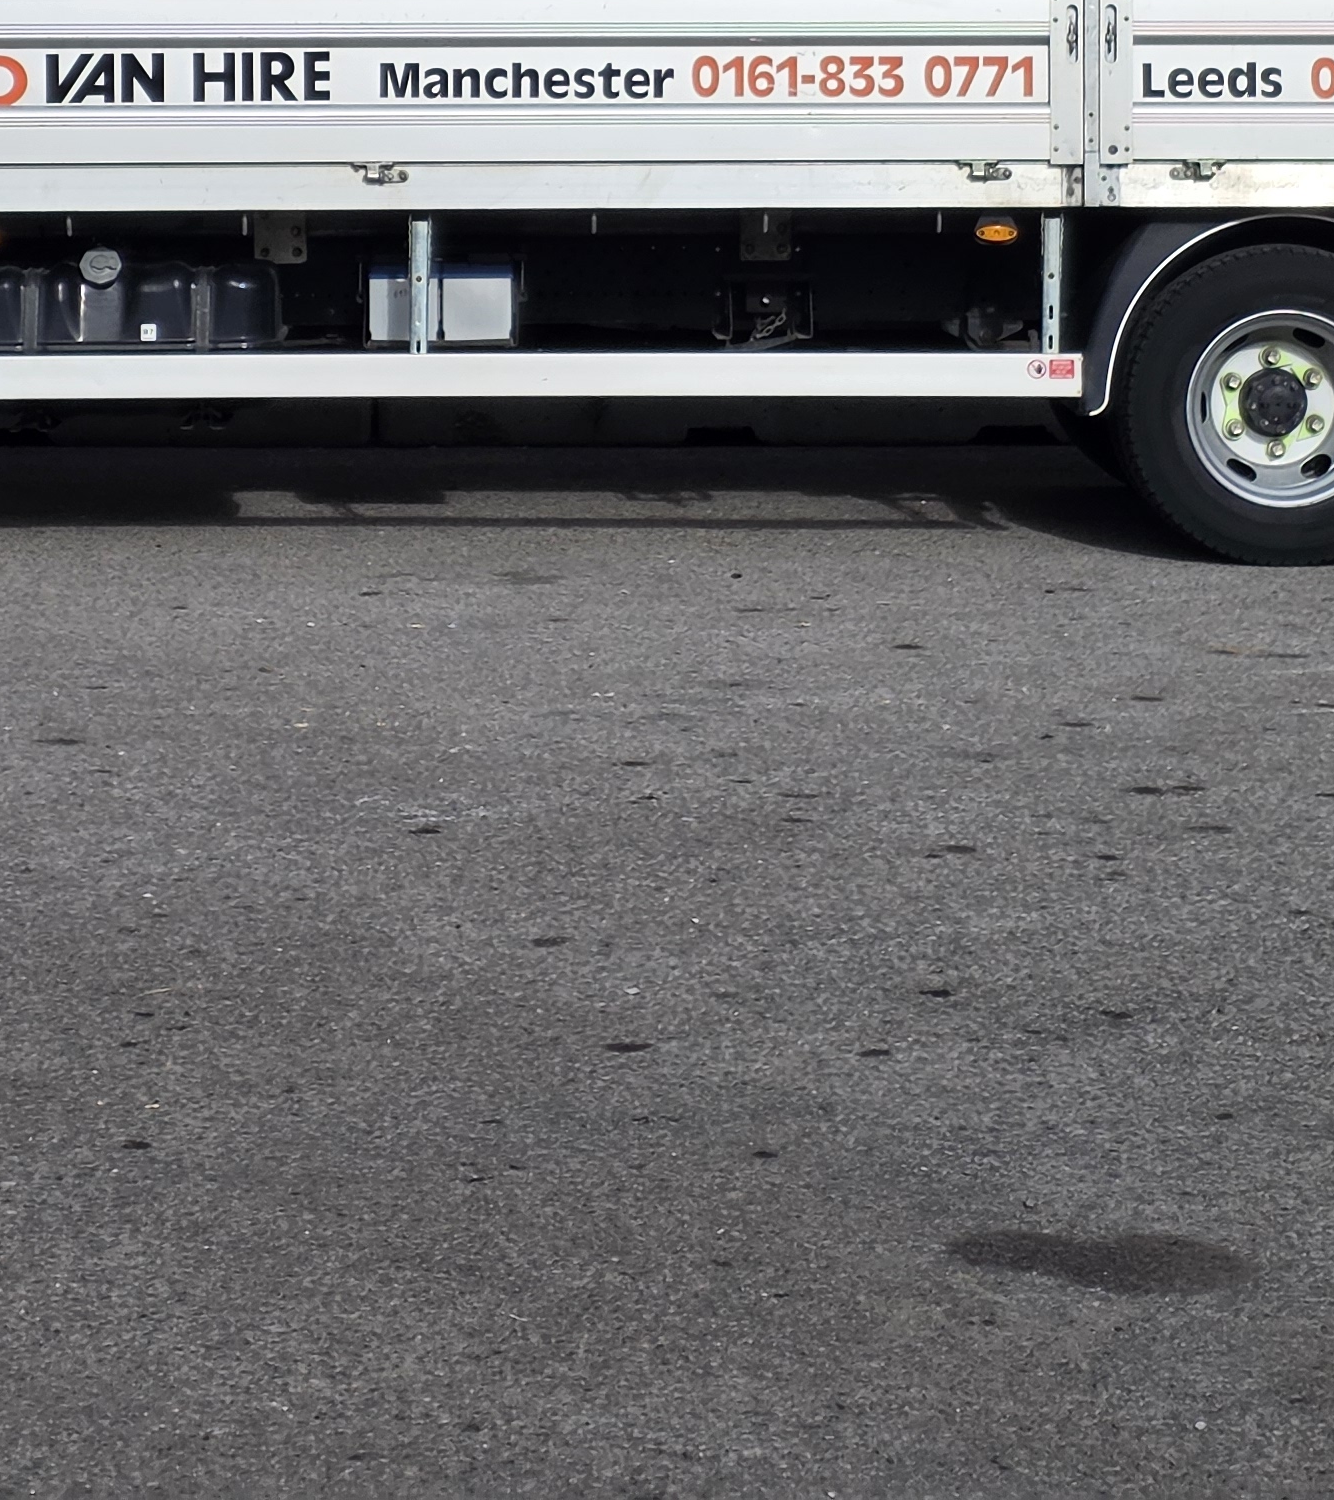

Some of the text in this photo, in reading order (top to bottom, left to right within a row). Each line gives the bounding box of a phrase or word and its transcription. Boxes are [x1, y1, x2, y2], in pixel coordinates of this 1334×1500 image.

[46, 52, 165, 103] VAN
[193, 51, 331, 102] HIRE
[379, 62, 675, 100] Manchester
[692, 55, 905, 98] 0161-833
[924, 55, 1034, 98] 0771
[1142, 62, 1283, 99] Leeds
